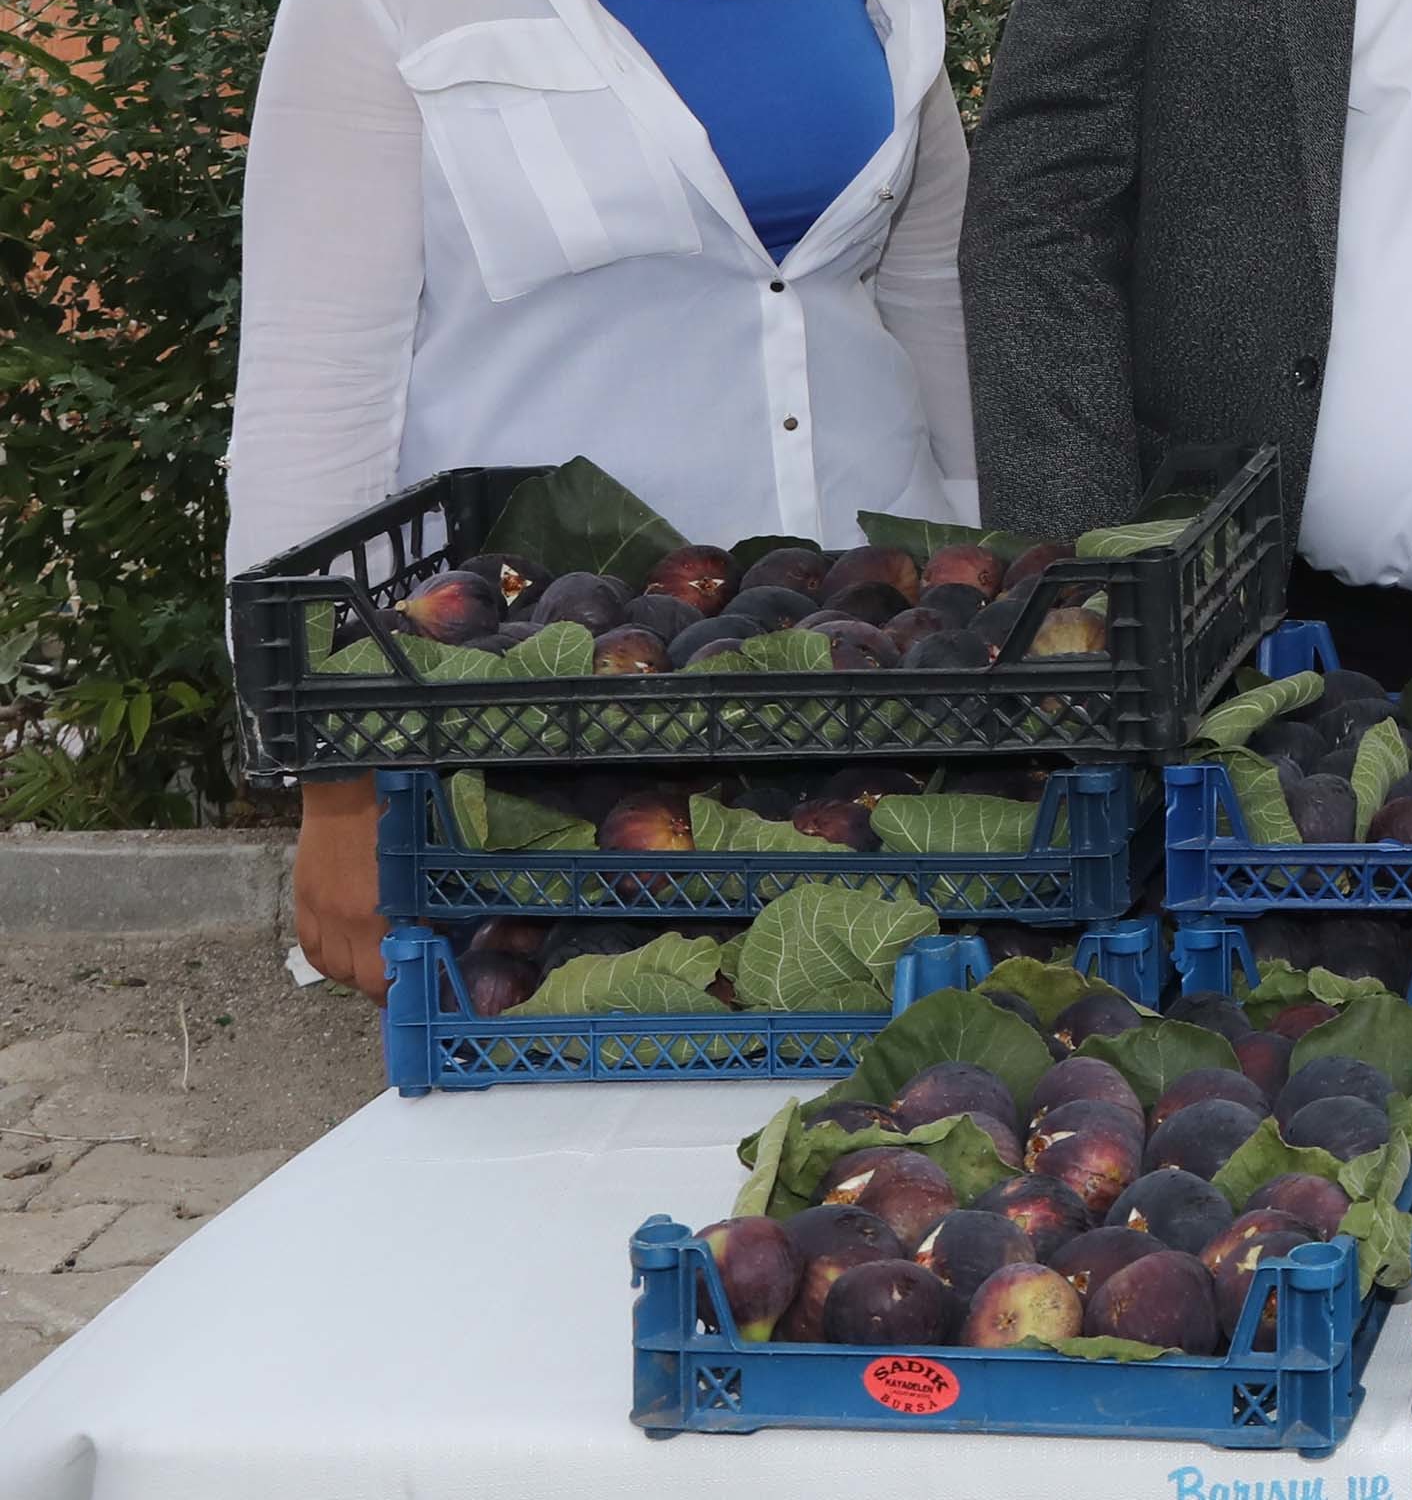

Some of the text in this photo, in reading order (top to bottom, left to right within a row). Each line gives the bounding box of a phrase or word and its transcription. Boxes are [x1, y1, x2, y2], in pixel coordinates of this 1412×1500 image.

[873, 1360, 949, 1395] SADIK
[880, 1393, 938, 1413] BURSA
[1347, 1474, 1393, 1500] ve
